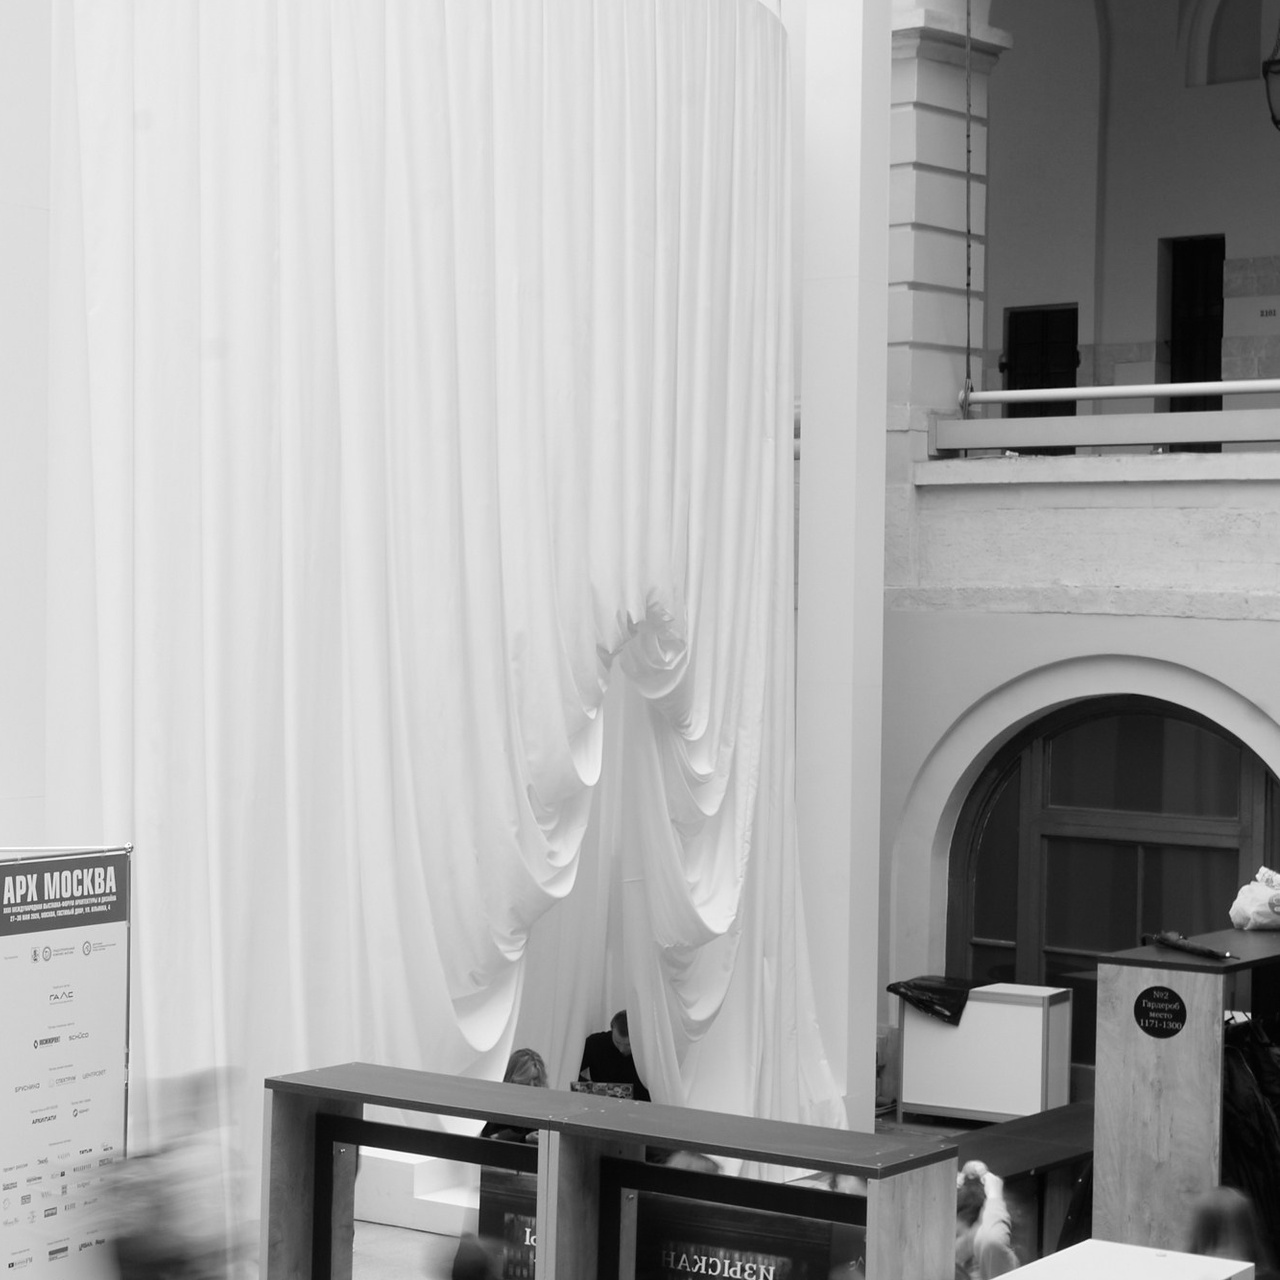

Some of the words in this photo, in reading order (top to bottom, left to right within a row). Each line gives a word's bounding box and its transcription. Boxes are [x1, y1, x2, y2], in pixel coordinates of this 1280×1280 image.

[3, 873, 38, 905] АРХ
[44, 866, 117, 901] МОСКВА
[1153, 990, 1169, 1000] №2
[1142, 999, 1180, 1011] Гардероб
[1149, 1012, 1173, 1020] место
